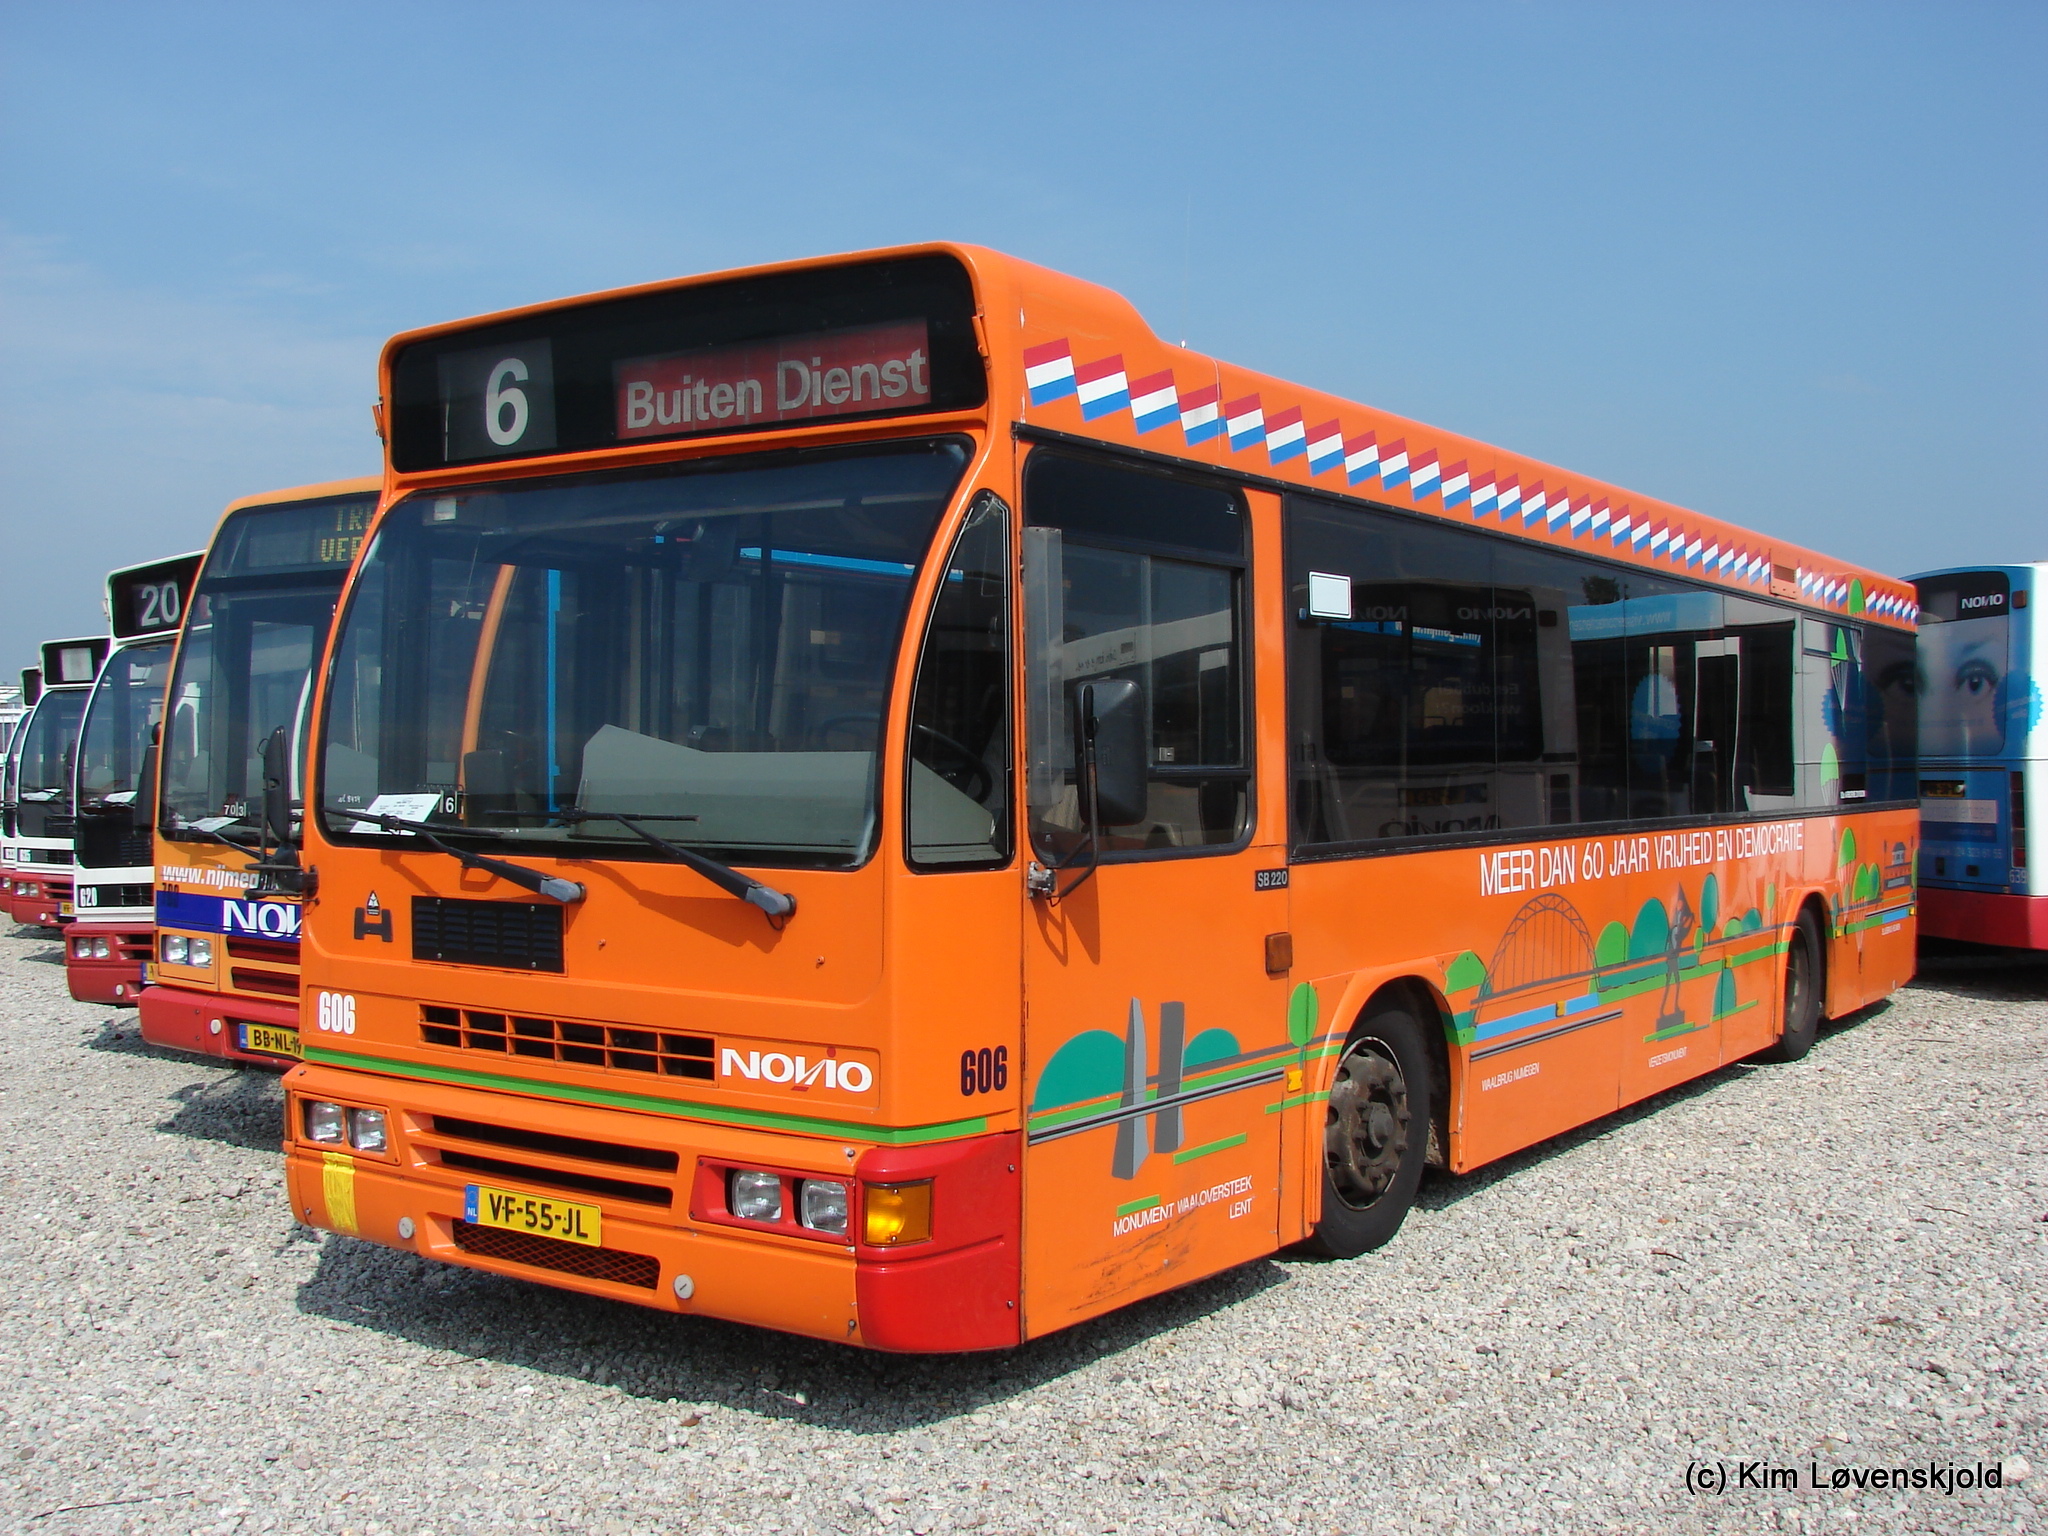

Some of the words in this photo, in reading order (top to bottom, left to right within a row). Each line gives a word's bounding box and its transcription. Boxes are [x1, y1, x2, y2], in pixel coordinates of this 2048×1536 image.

[485, 358, 529, 446] 6
[626, 374, 763, 429] Buiten
[776, 348, 928, 412] Dienst
[141, 581, 181, 627] 20
[1961, 593, 2004, 610] NOVIO
[1257, 872, 1270, 888] SB
[1271, 870, 1288, 886] 220
[1480, 849, 1535, 897] MEER
[1539, 845, 1575, 888] DAN
[1581, 842, 1604, 881] 60
[1609, 837, 1649, 877] JAAR
[1653, 830, 1713, 870] VRIJHEID
[1716, 830, 1733, 862] EN
[1736, 822, 1803, 858] DEMOCRATIE
[80, 887, 97, 907] 620
[319, 991, 356, 1035] 606
[721, 1047, 873, 1093] NOVIO
[960, 1045, 1008, 1097] 606
[489, 1193, 589, 1239] VF-55-JL
[1113, 1202, 1174, 1237] MONUMENT
[1229, 1198, 1253, 1219] LENT
